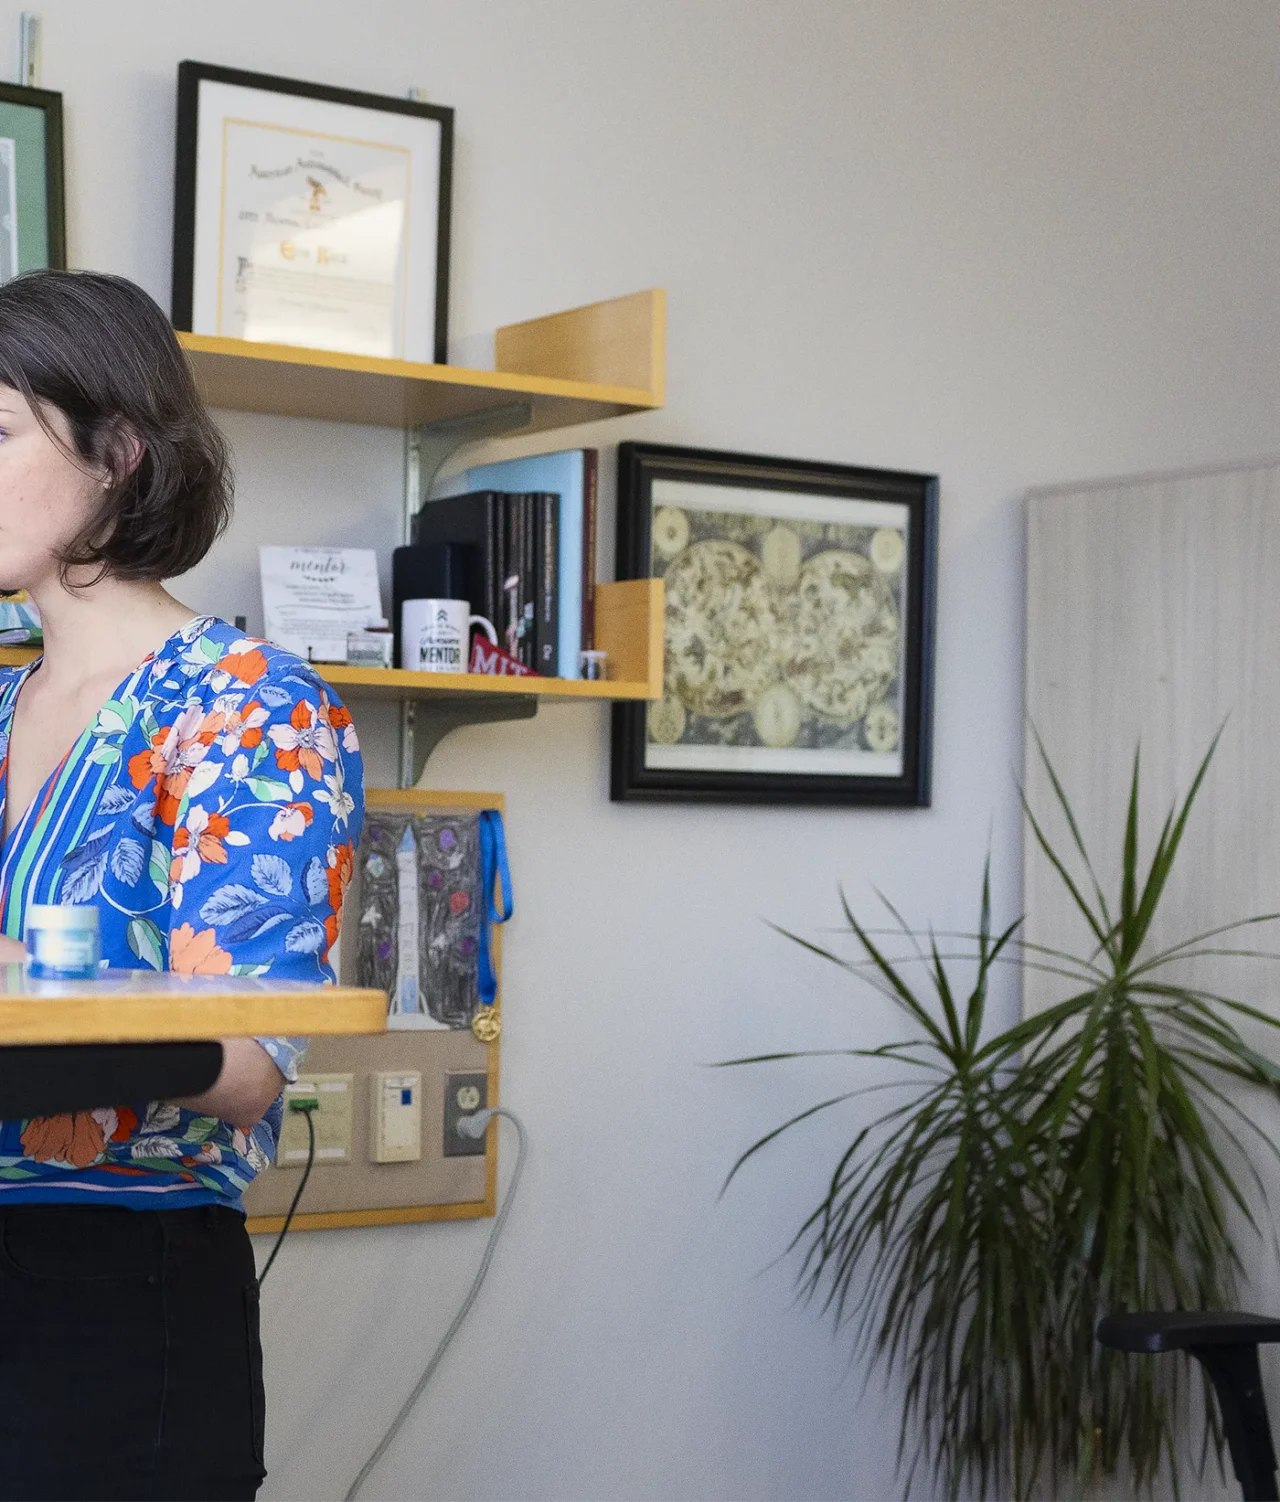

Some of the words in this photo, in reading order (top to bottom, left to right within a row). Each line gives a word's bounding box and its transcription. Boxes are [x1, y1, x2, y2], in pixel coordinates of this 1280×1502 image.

[290, 557, 348, 575] mentor
[420, 647, 462, 664] MENTOR
[473, 644, 528, 676] MIT
